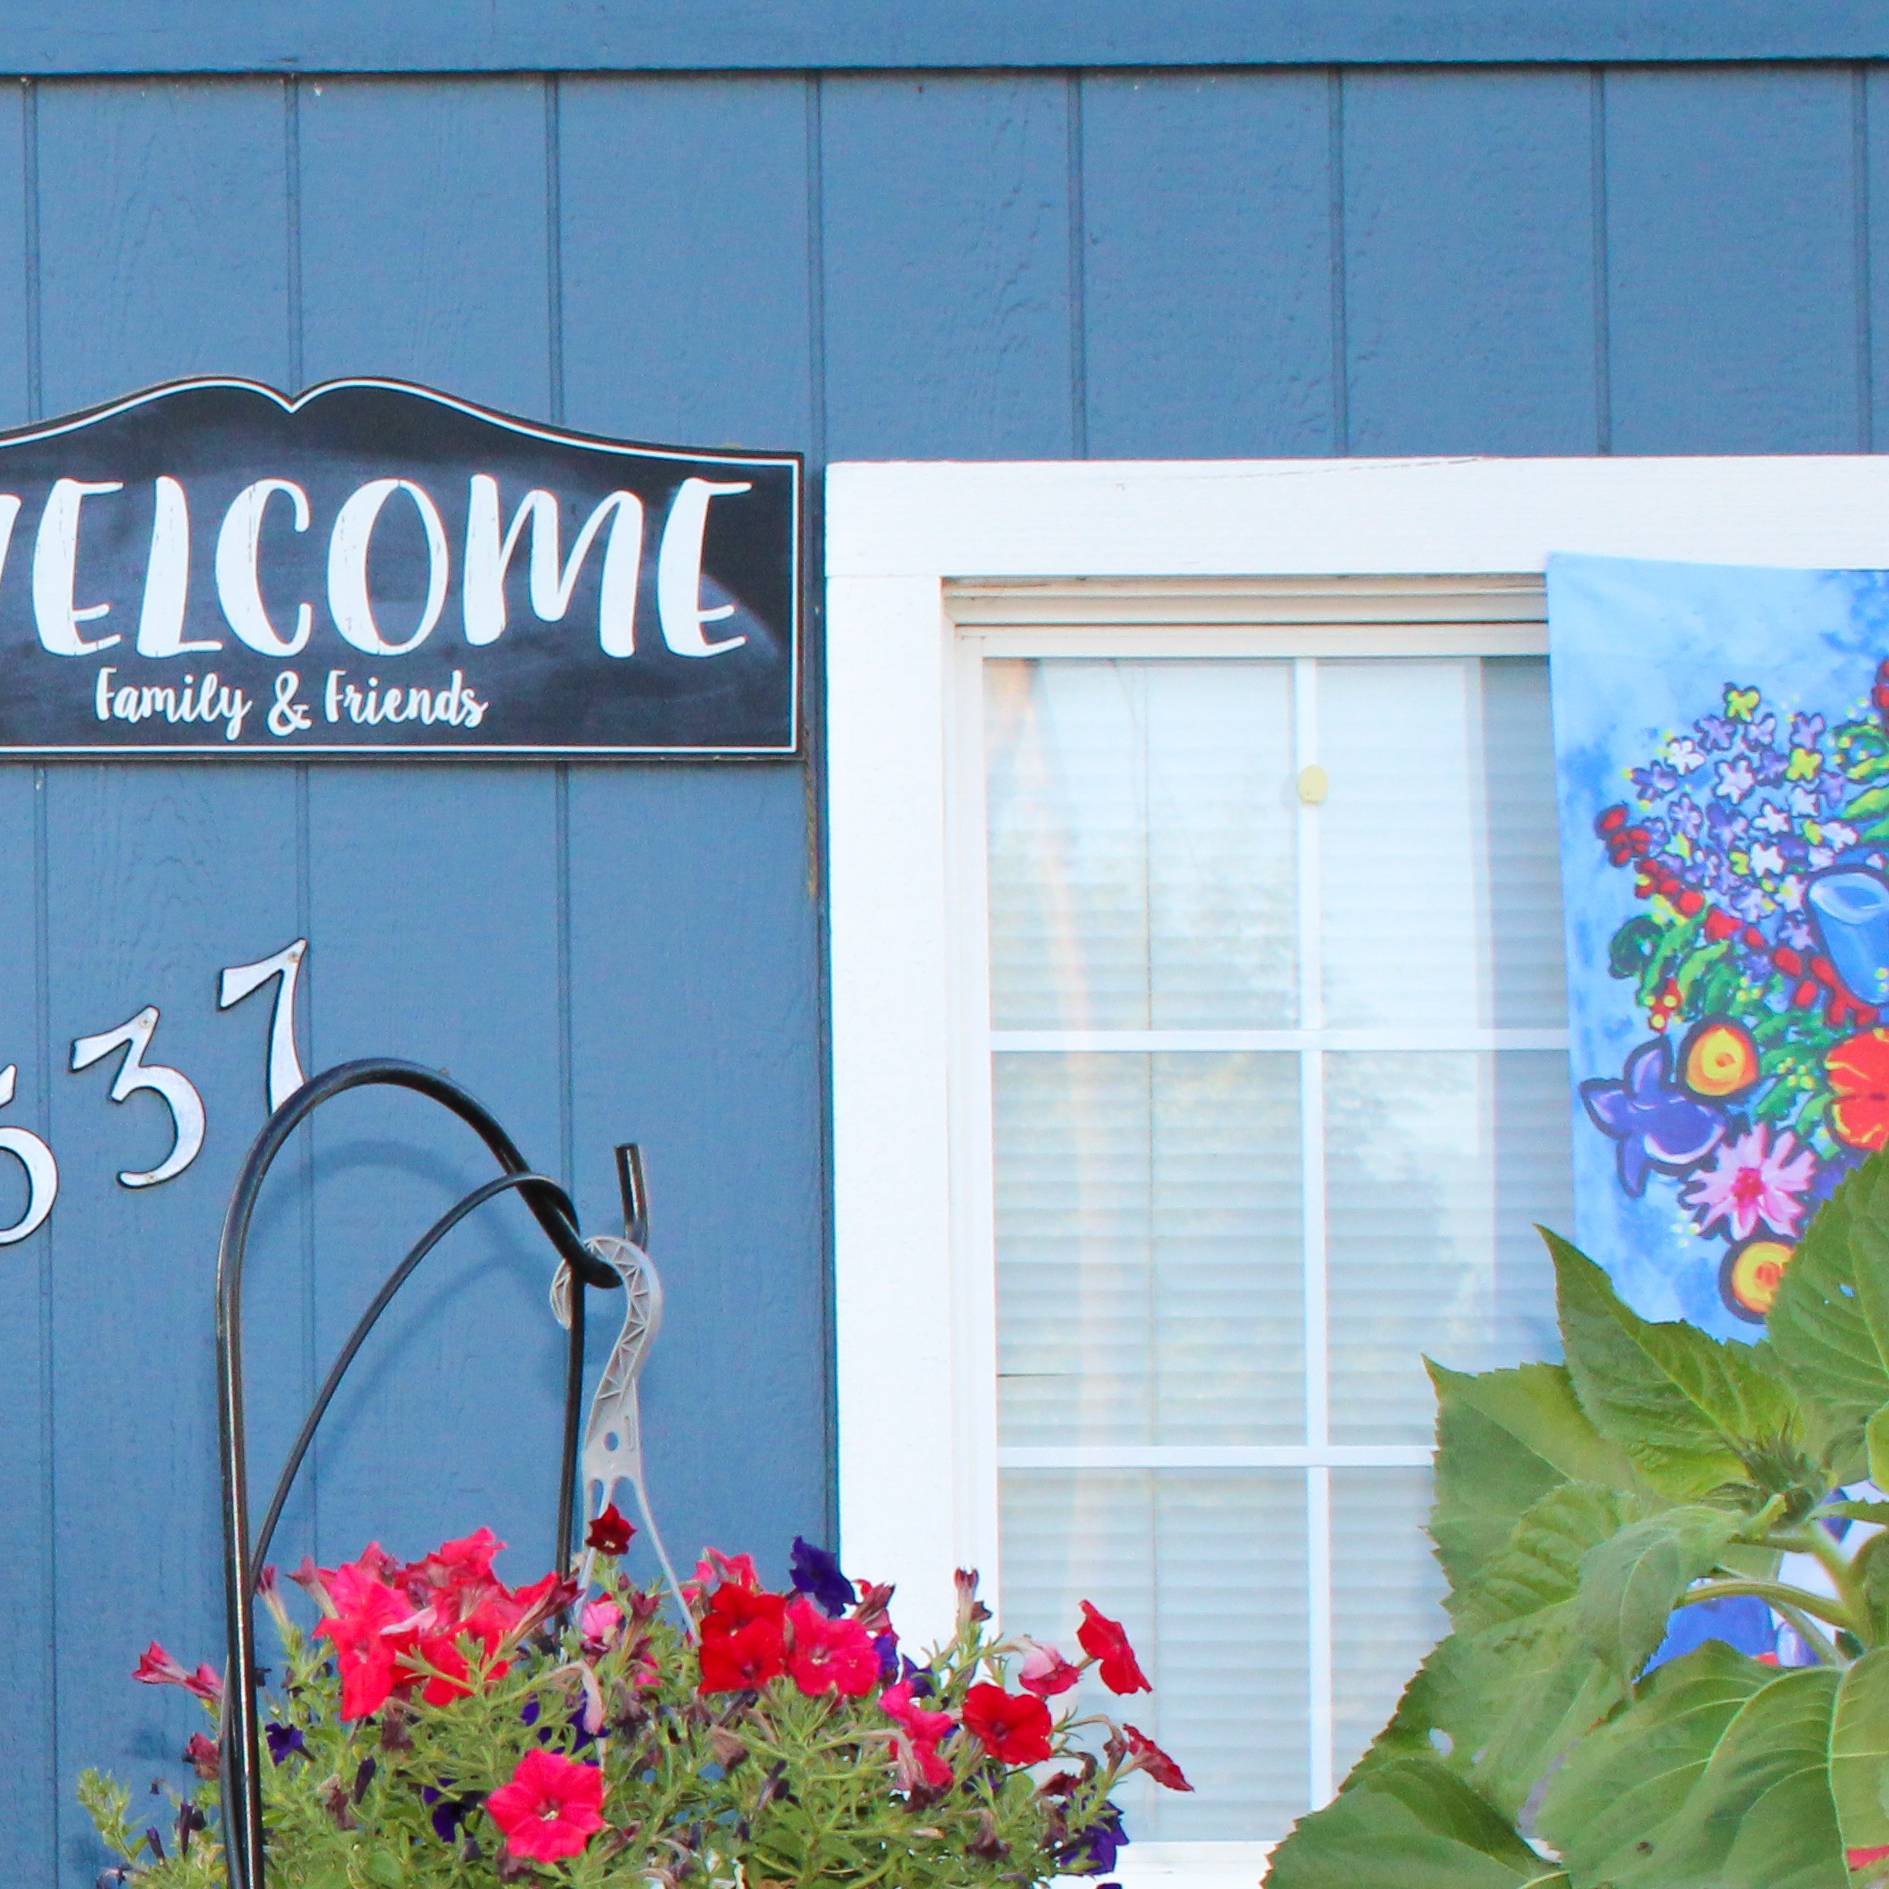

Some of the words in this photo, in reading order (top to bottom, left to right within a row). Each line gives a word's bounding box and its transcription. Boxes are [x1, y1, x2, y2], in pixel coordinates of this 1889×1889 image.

[94, 666, 250, 741] Family
[268, 671, 311, 738] &
[325, 669, 488, 728] Friends
